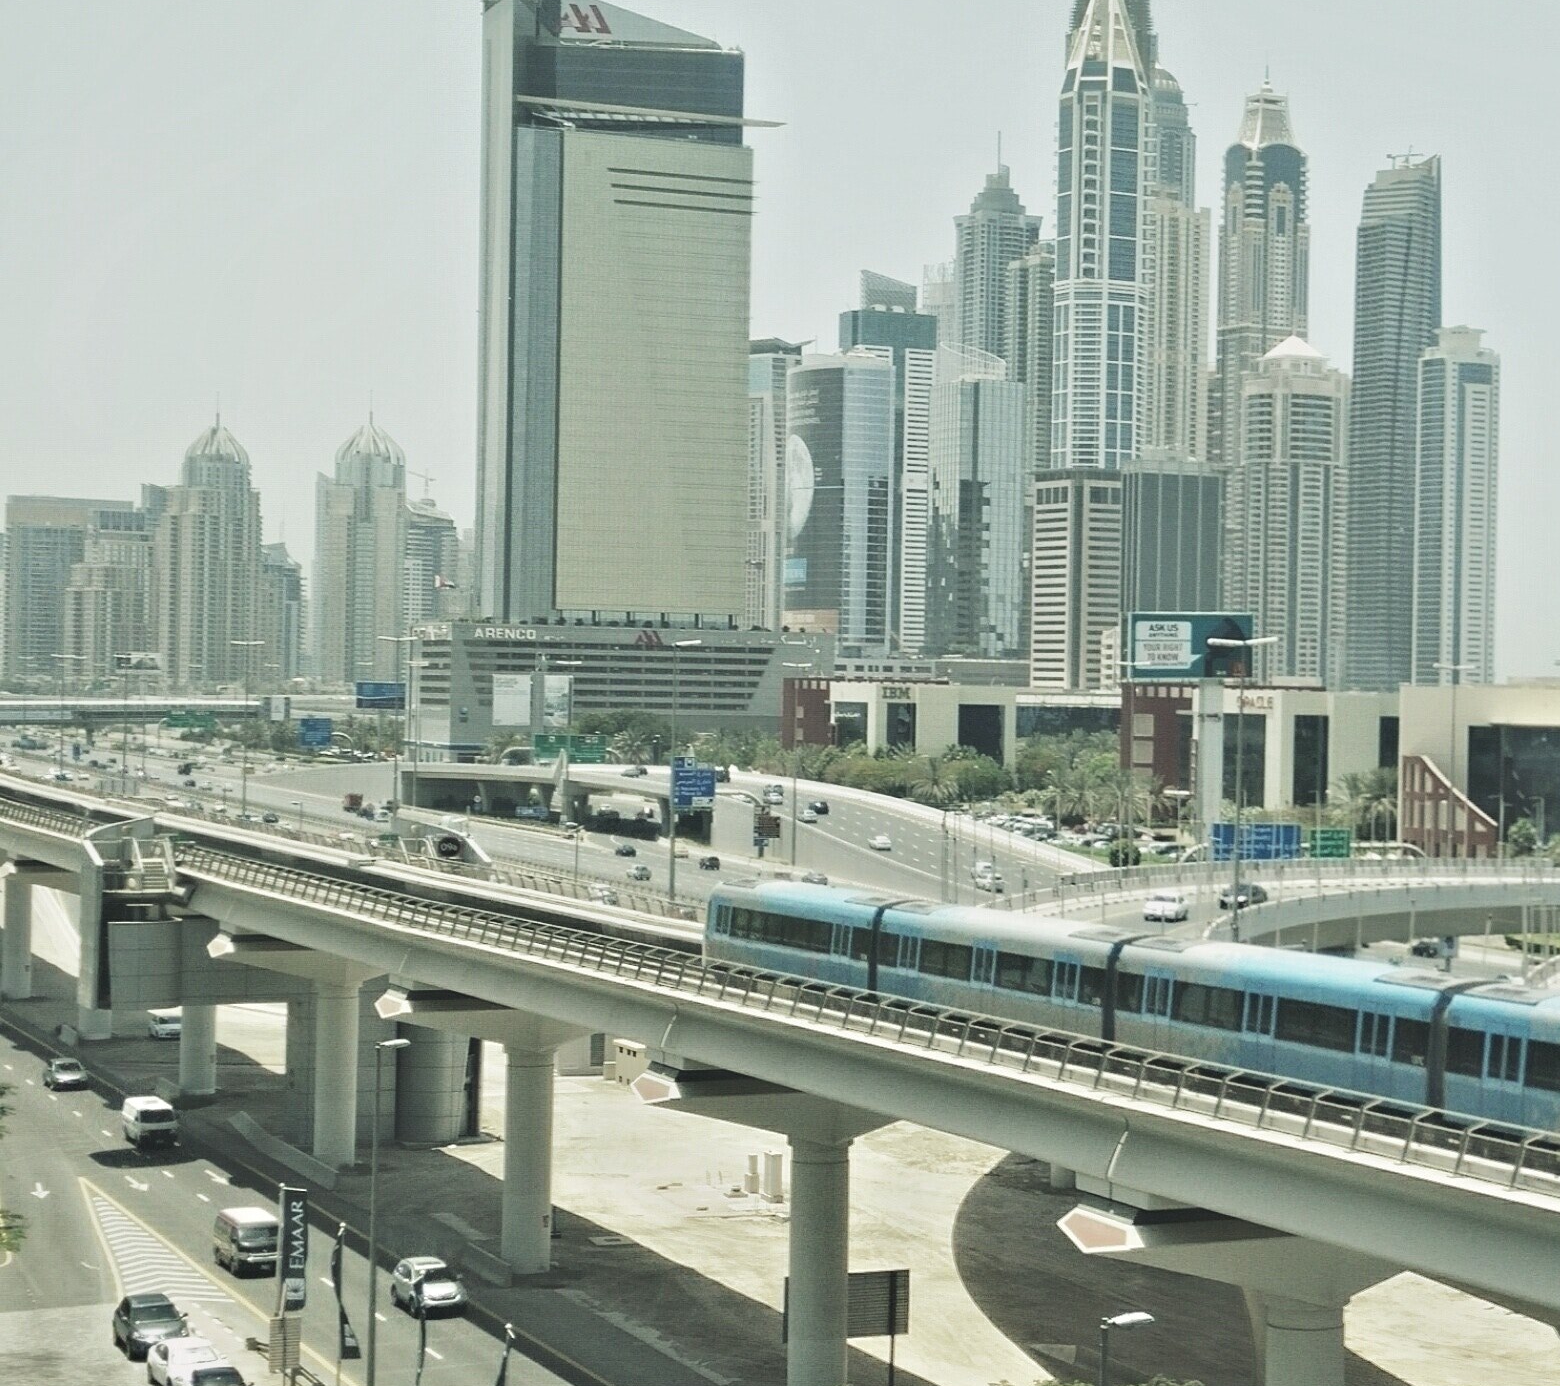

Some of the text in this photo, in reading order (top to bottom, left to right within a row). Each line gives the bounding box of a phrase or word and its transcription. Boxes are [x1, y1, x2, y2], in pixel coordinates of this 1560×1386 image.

[1149, 623, 1179, 631] ASK US
[474, 627, 537, 641] ARENCO
[1143, 643, 1161, 651] YOUR
[1157, 653, 1178, 661] KNOW
[882, 687, 911, 699] IBM
[289, 1200, 305, 1269] EMAAR
